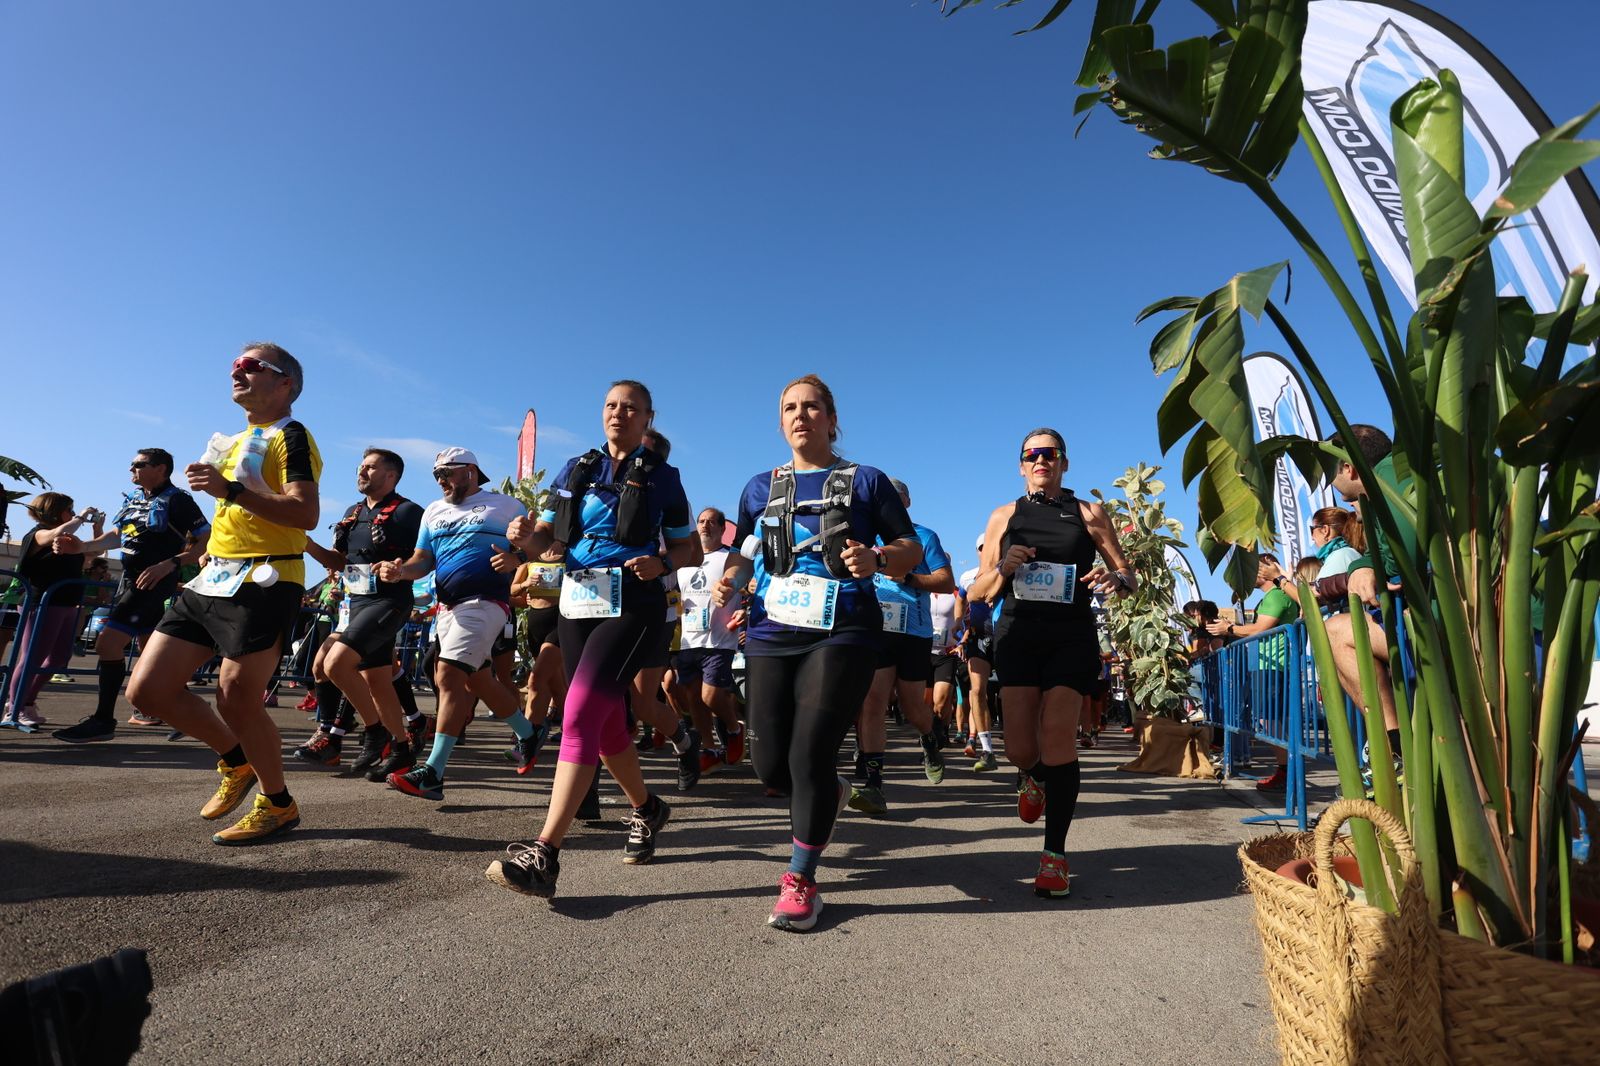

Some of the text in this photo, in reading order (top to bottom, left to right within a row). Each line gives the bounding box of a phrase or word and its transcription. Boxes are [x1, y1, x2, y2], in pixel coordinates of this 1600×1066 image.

[434, 519, 457, 532] Stop
[469, 515, 485, 525] Go
[1024, 572, 1054, 586] 840
[571, 584, 598, 601] 600
[611, 572, 619, 613] PIRATILLA
[777, 590, 811, 607] 583
[823, 582, 836, 626] PIRATILLA
